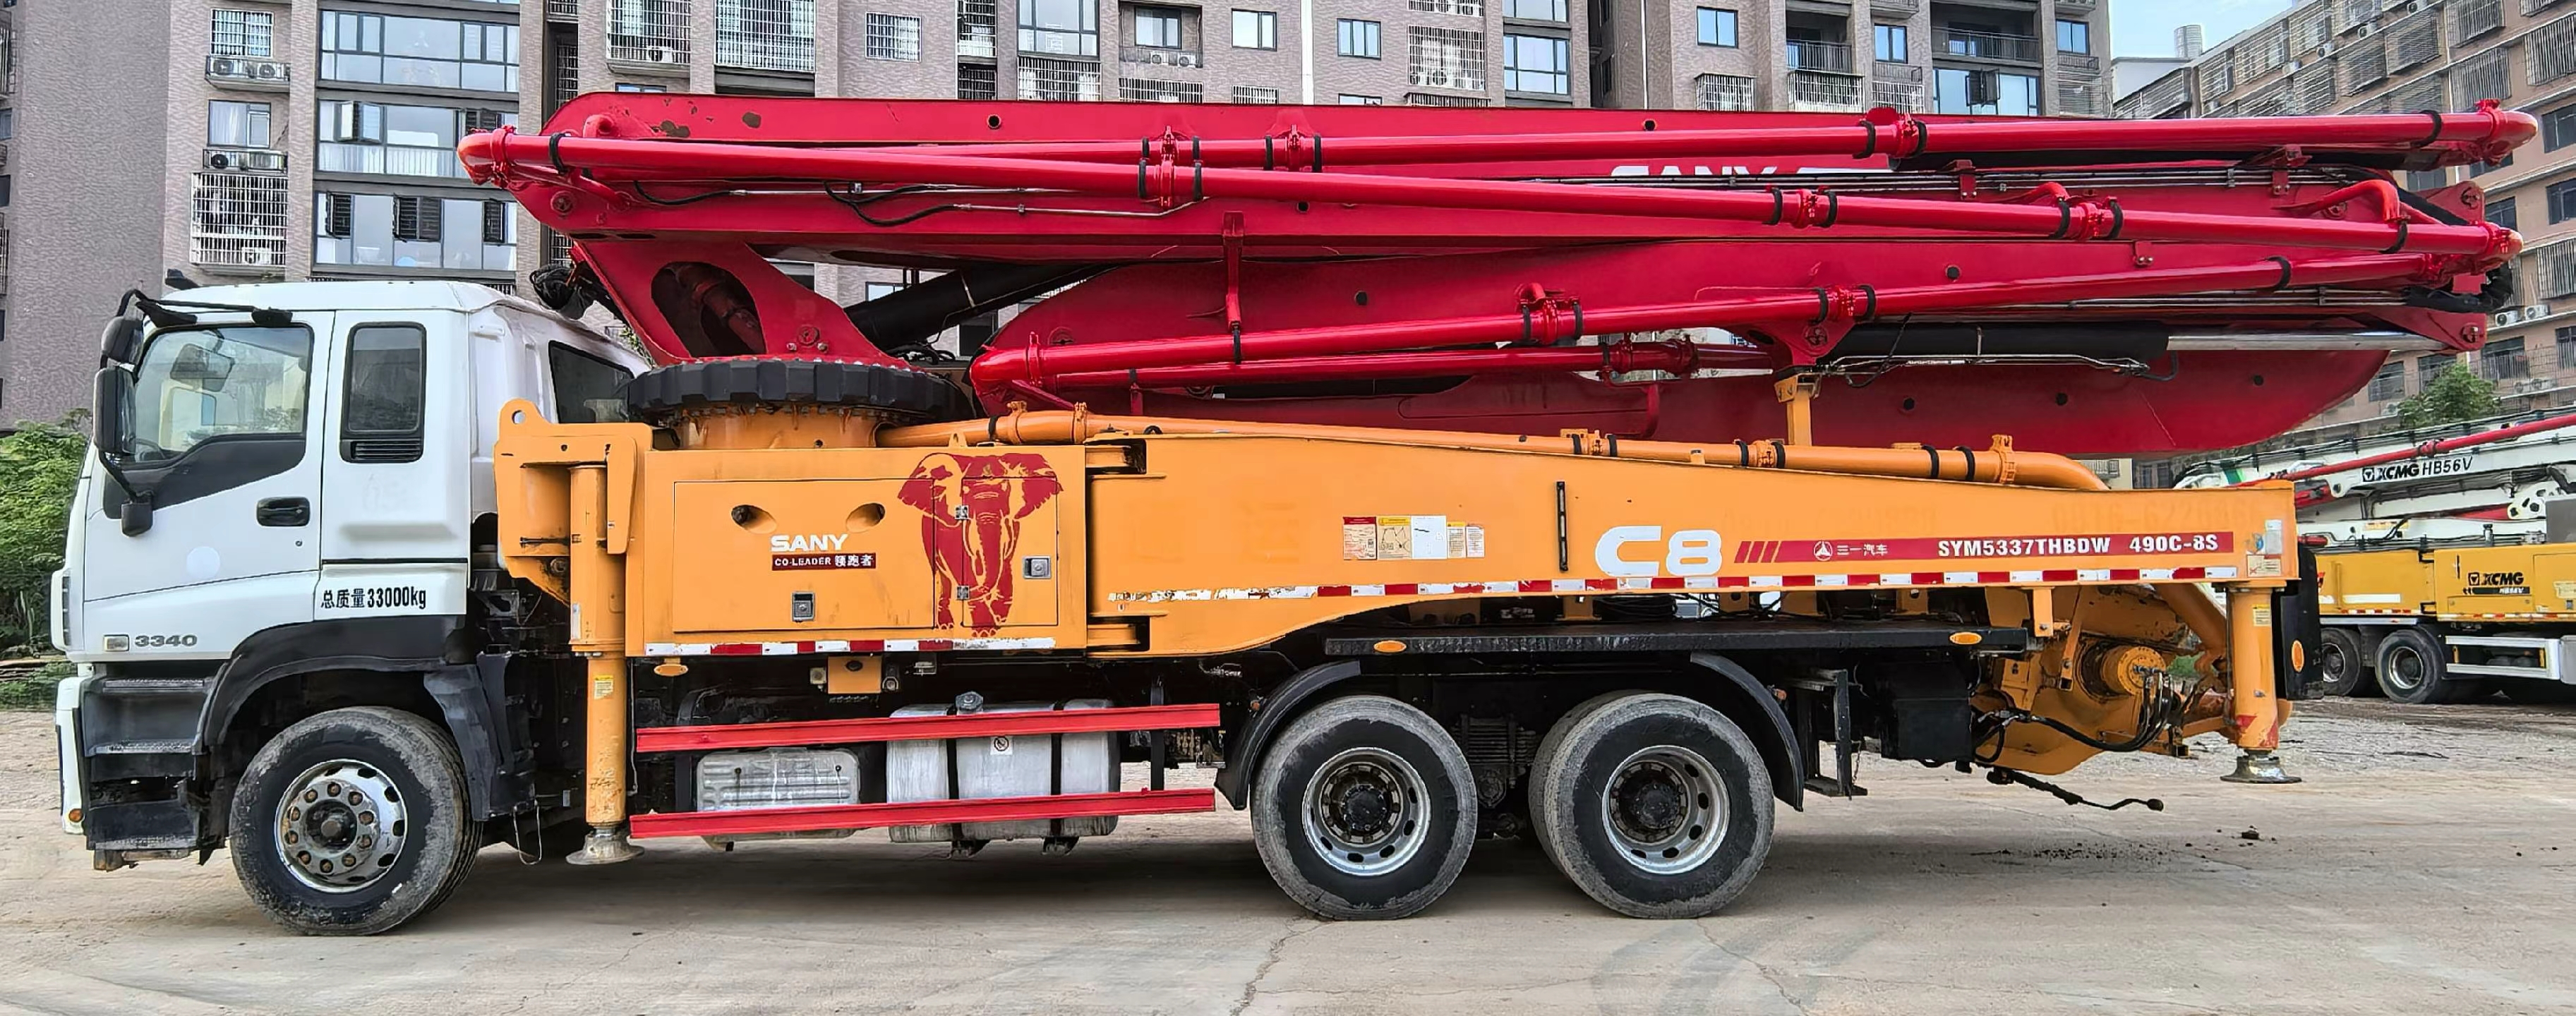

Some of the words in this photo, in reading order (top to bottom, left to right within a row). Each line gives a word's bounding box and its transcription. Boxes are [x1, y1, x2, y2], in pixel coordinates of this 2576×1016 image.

[2376, 463, 2420, 480] XCMG
[2422, 456, 2473, 476] HB56V
[771, 534, 848, 552] SANY
[1595, 526, 1722, 577] C8
[1836, 544, 1889, 556] 三一汽车
[1938, 537, 2111, 557] SYM5337THBDW
[2129, 534, 2219, 552] 490C-8S
[2481, 572, 2524, 586] XCMG
[320, 586, 426, 610] 总质量33000kg
[135, 635, 198, 647] 3340
